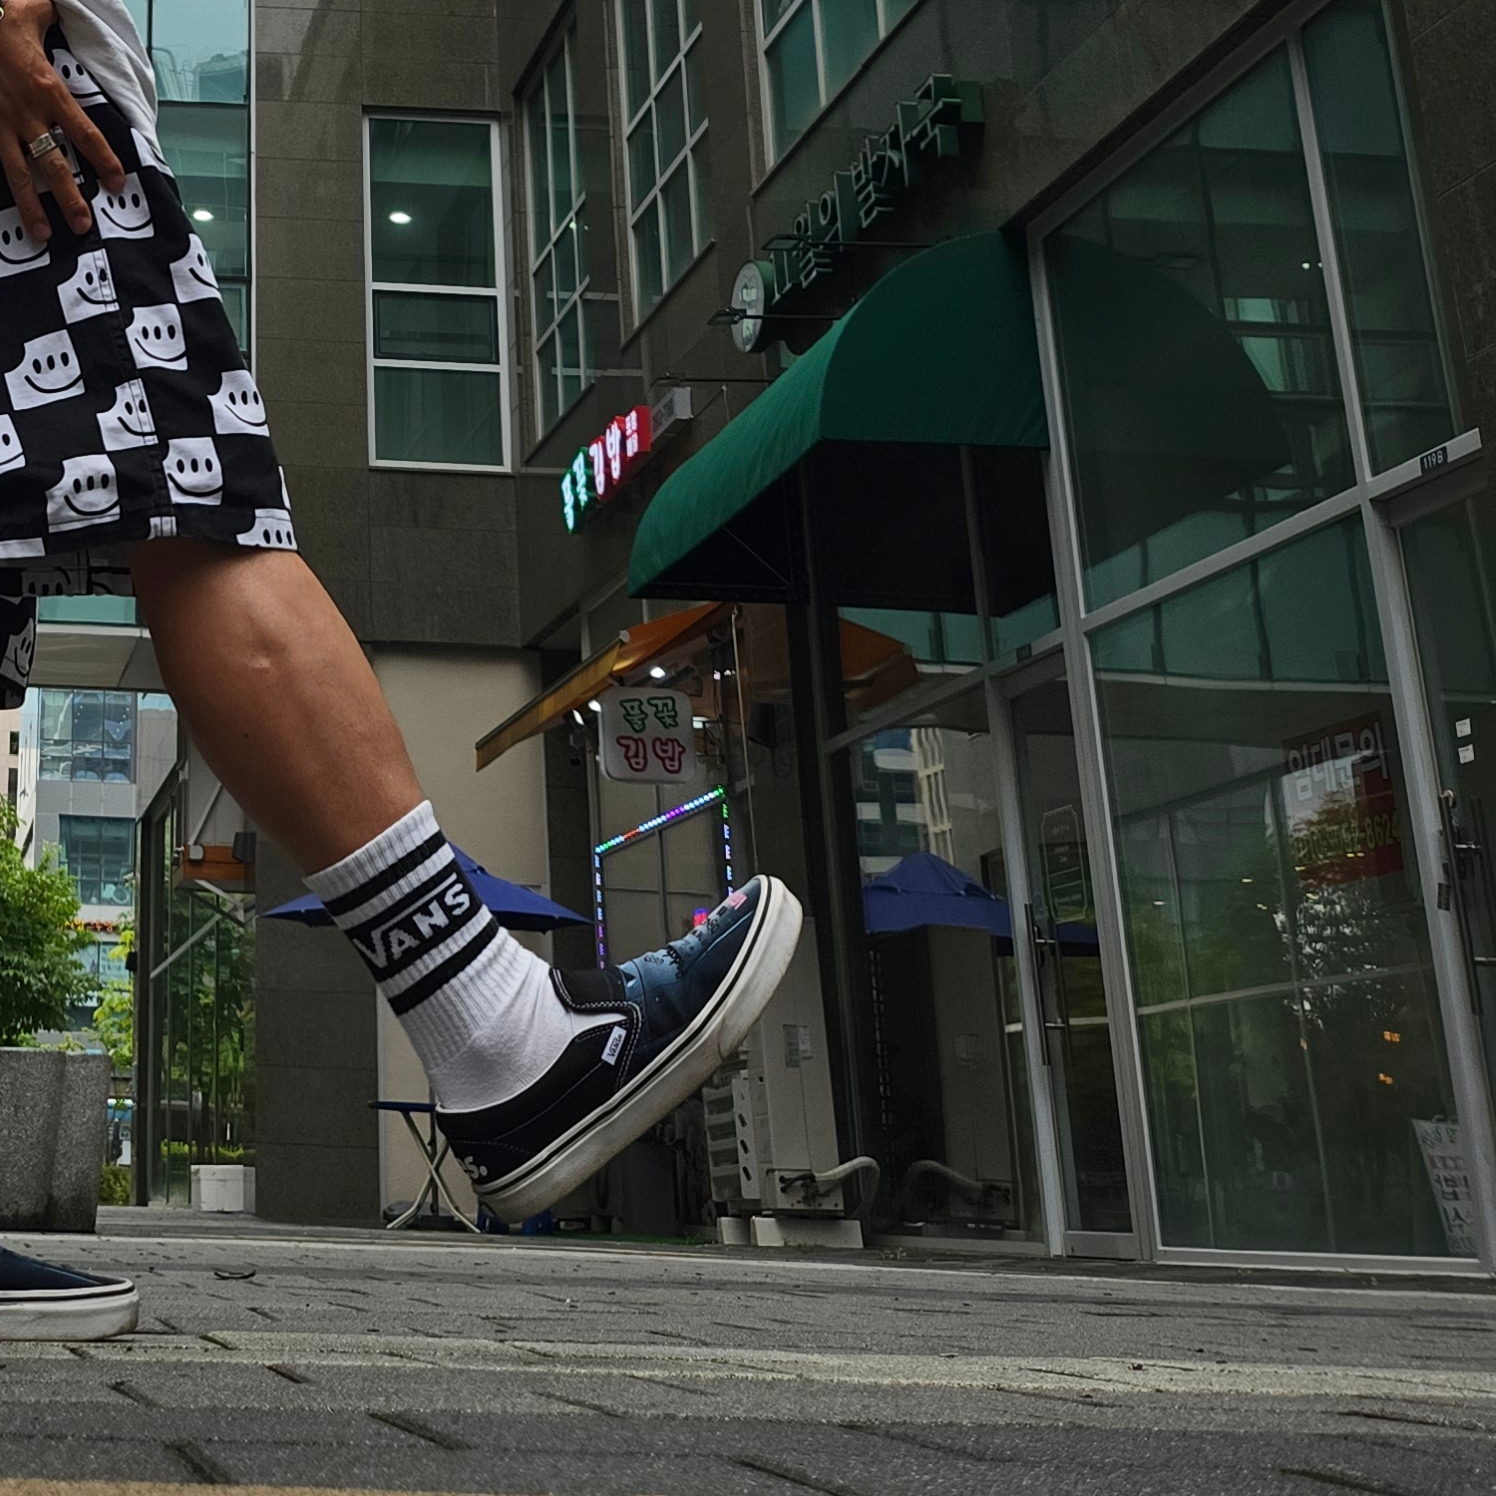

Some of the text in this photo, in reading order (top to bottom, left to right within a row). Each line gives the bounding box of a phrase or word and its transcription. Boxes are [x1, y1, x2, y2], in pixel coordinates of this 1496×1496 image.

[1423, 450, 1444, 470] 119B
[619, 696, 679, 733] 풀꽃
[616, 735, 686, 774] 김밥
[1288, 721, 1388, 801] 임대문의
[356, 872, 473, 970] VANS
